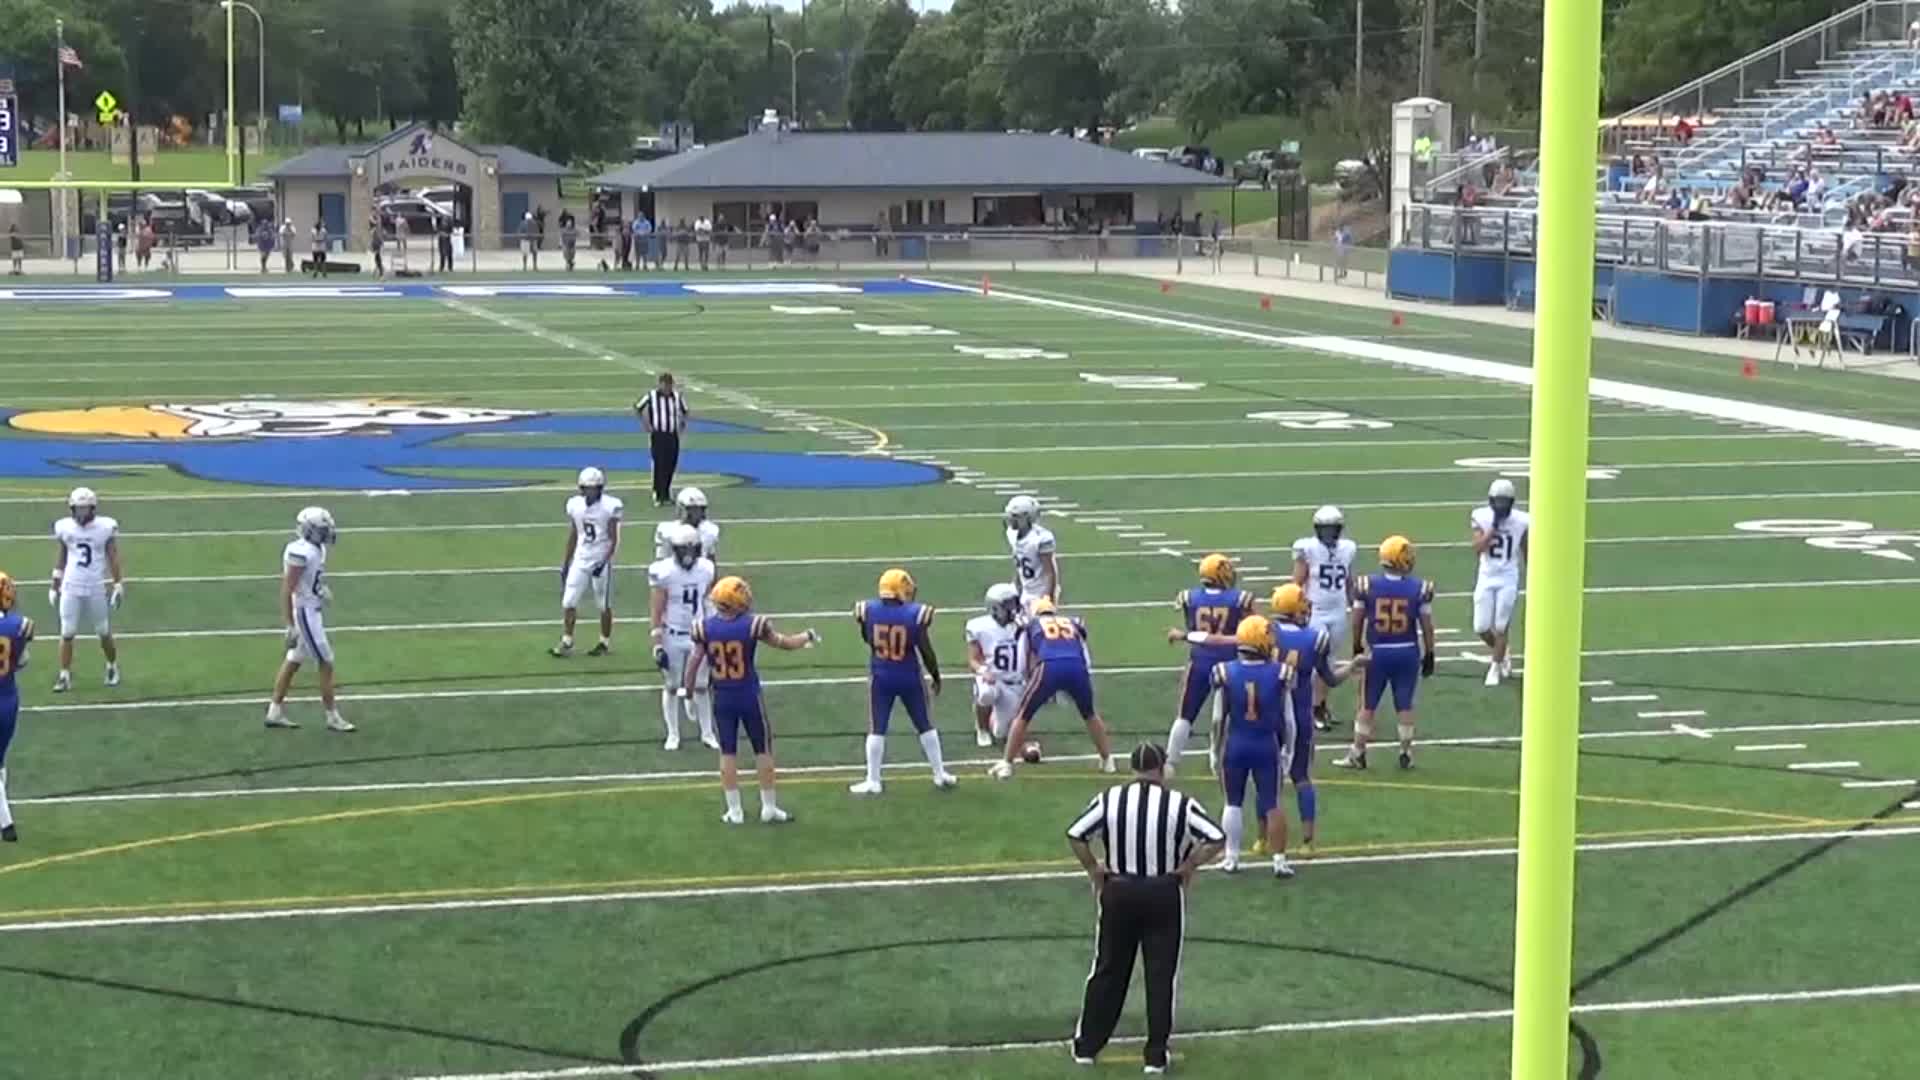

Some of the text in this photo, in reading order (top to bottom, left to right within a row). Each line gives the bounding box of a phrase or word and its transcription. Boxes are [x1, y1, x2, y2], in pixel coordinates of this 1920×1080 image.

[583, 522, 597, 543] 9
[76, 543, 92, 568] 3
[1489, 535, 1513, 560] 21
[1319, 564, 1347, 590] 52
[682, 585, 698, 615] 4
[1195, 606, 1229, 635] 67
[1375, 597, 1408, 633] 55
[873, 624, 907, 661] 50
[708, 641, 745, 680] 33
[994, 644, 1018, 671] 61
[1245, 681, 1258, 721] 1
